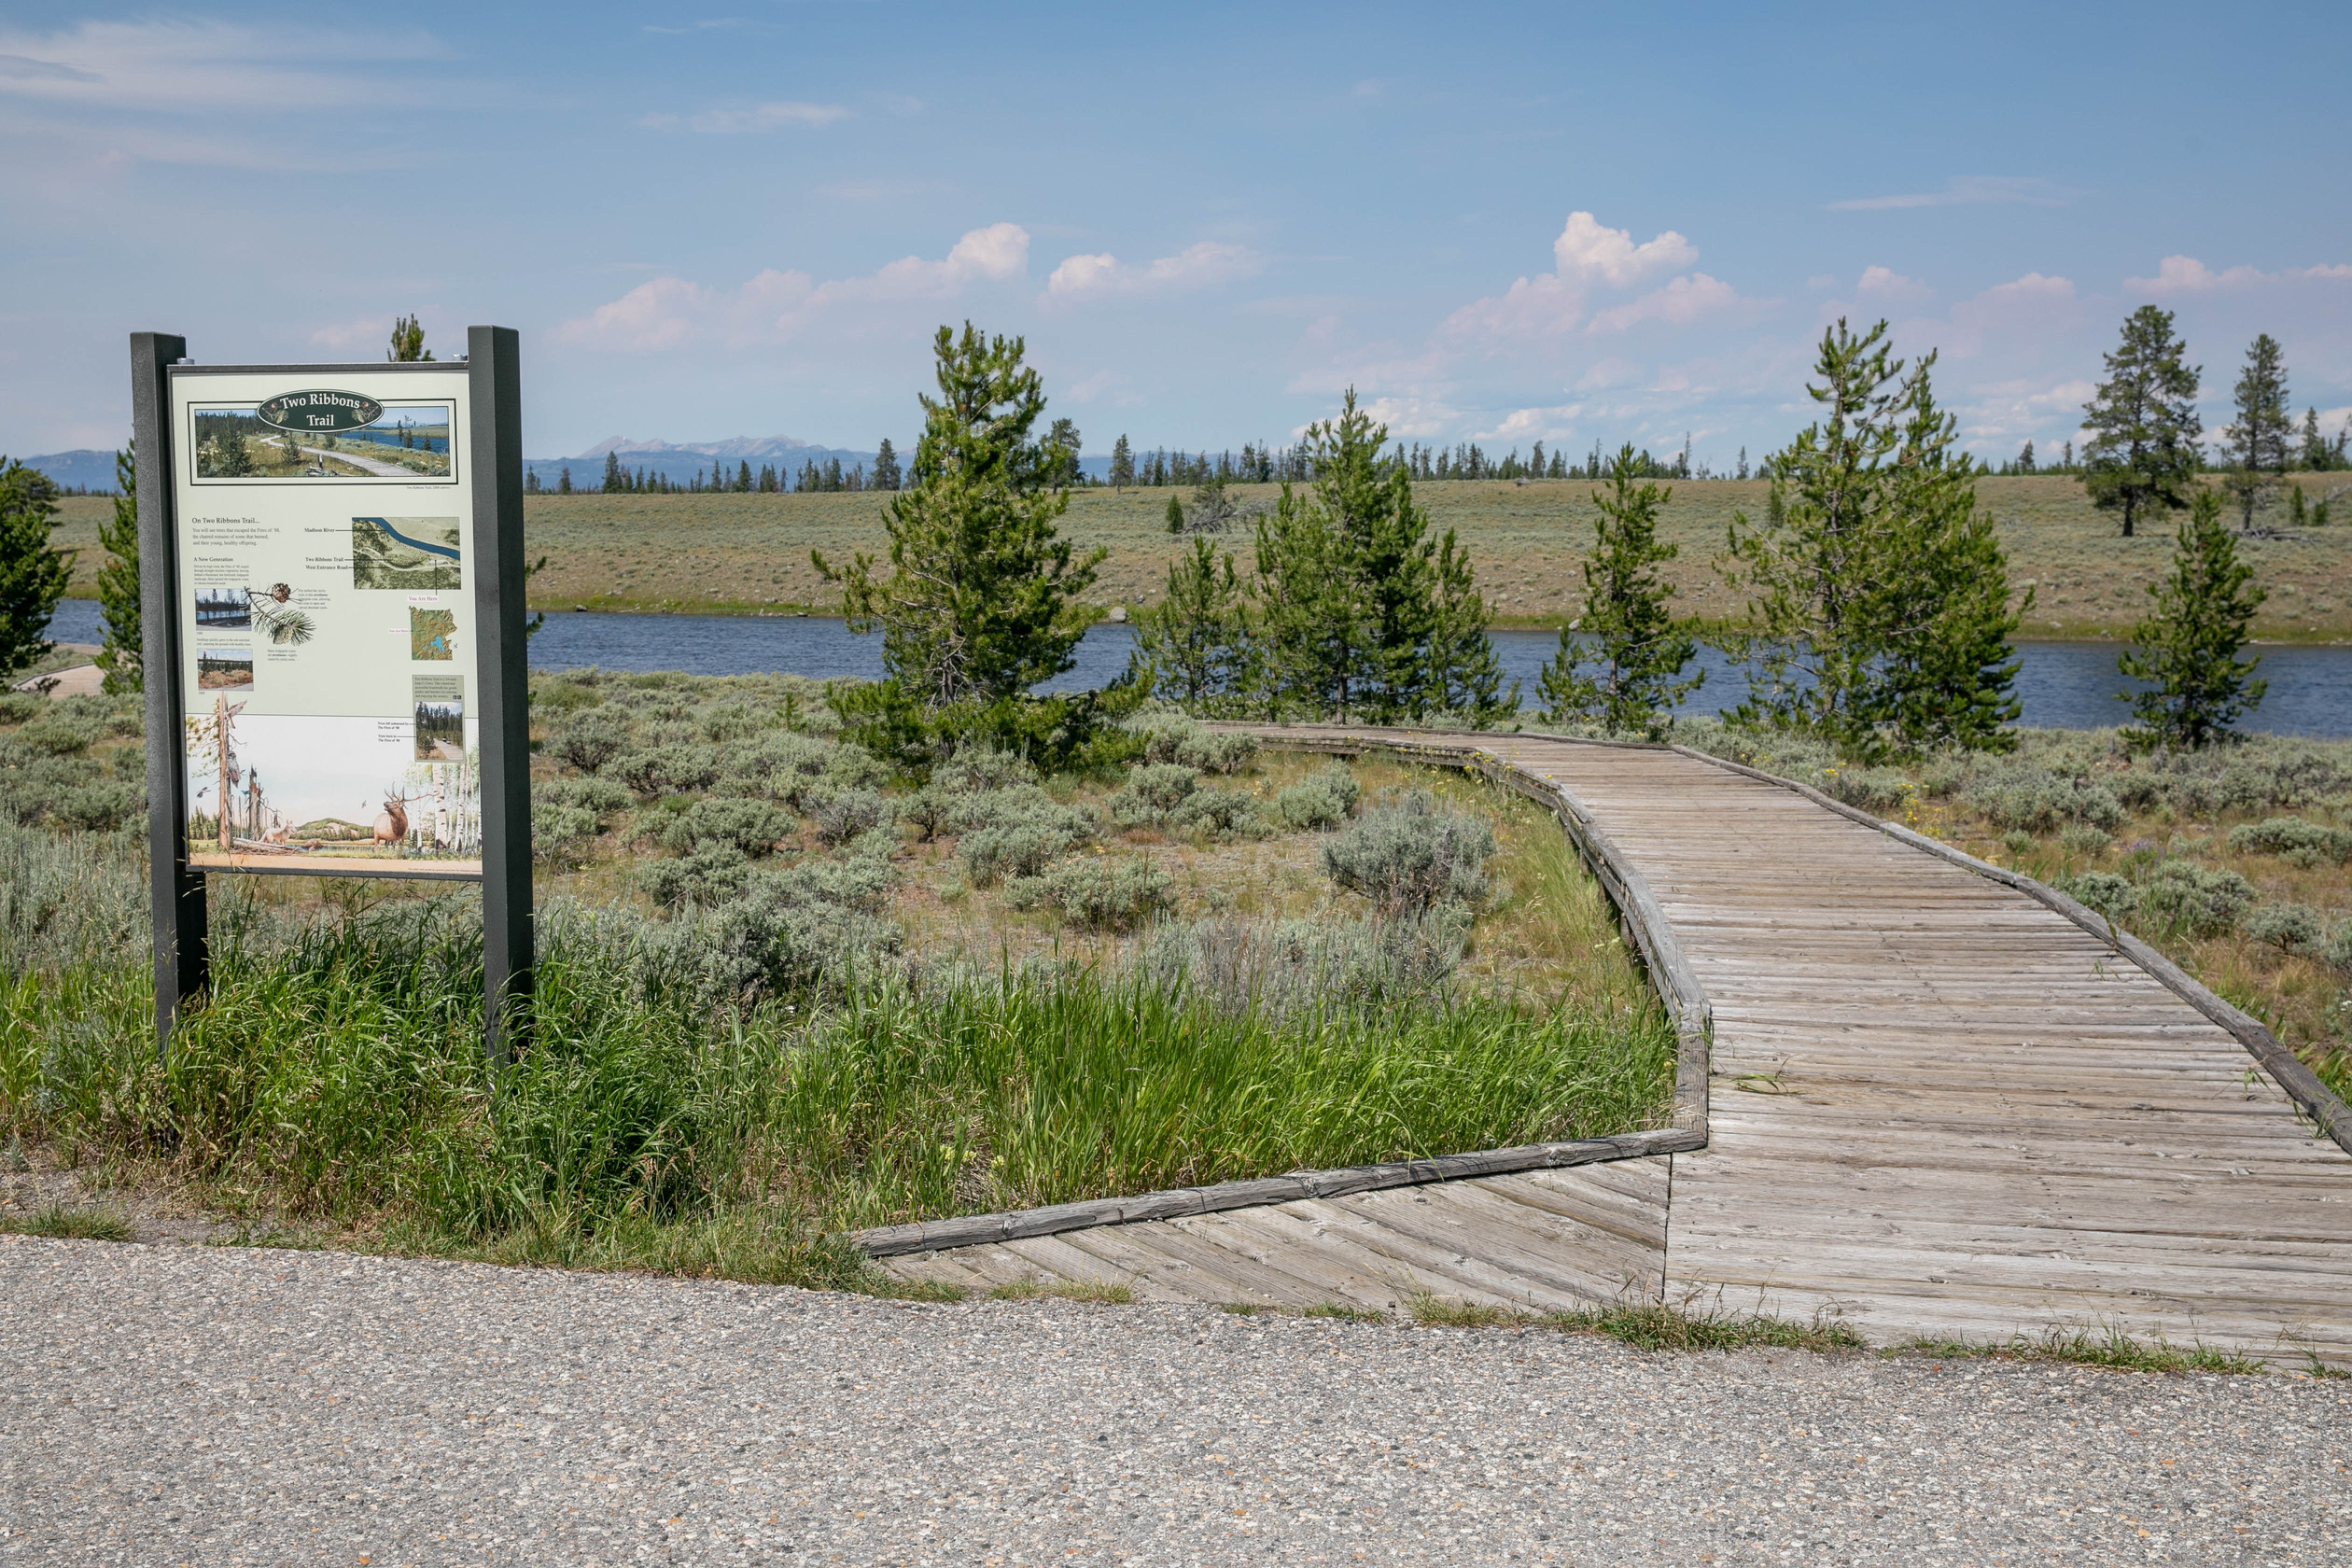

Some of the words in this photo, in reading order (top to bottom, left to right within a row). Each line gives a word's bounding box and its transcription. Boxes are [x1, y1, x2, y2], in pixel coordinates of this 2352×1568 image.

[280, 397, 306, 409] Two
[309, 393, 360, 409] Ribbons
[306, 414, 334, 426] Trail
